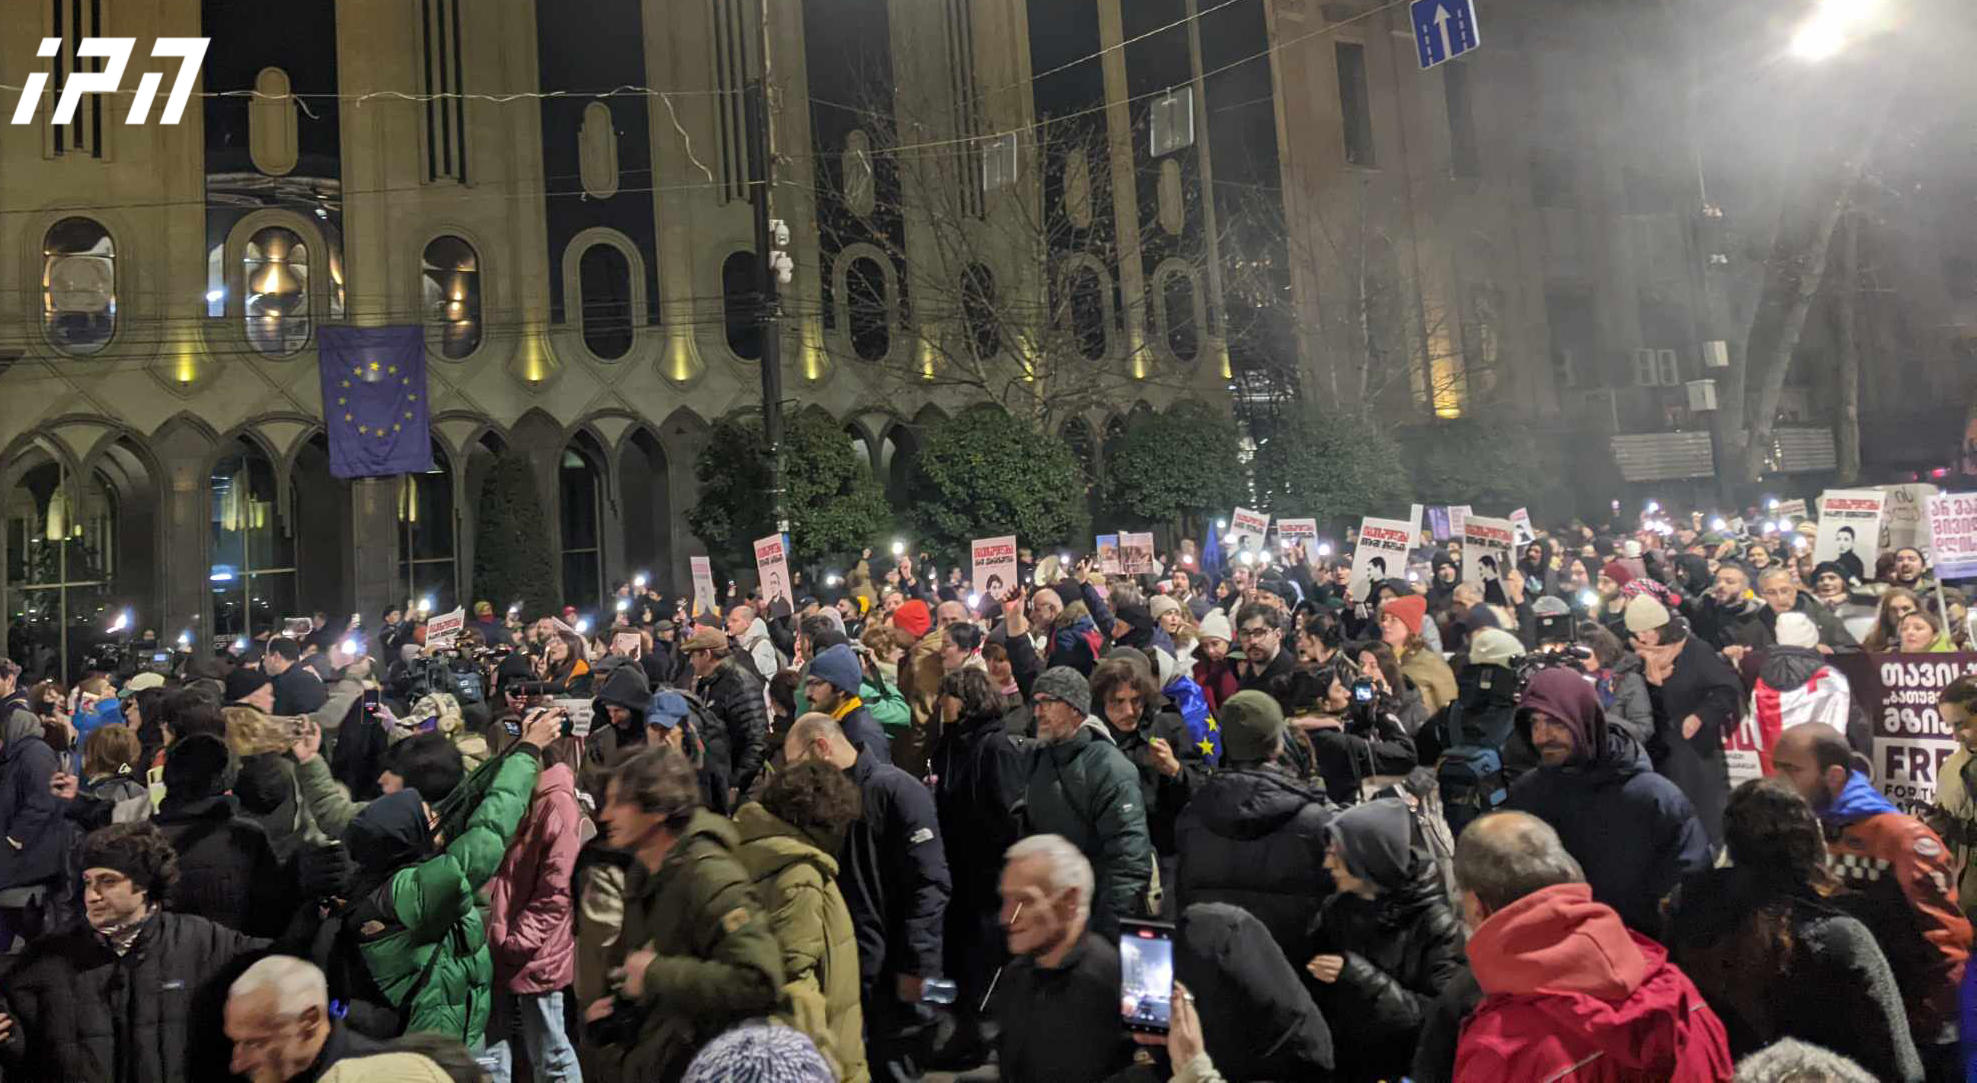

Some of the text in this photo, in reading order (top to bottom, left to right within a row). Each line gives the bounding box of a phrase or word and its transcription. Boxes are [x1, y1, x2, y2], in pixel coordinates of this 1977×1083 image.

[1953, 498, 1977, 516] ვა
[1882, 691, 1941, 705] „ბათუმ
[1884, 784, 1917, 798] FOR
